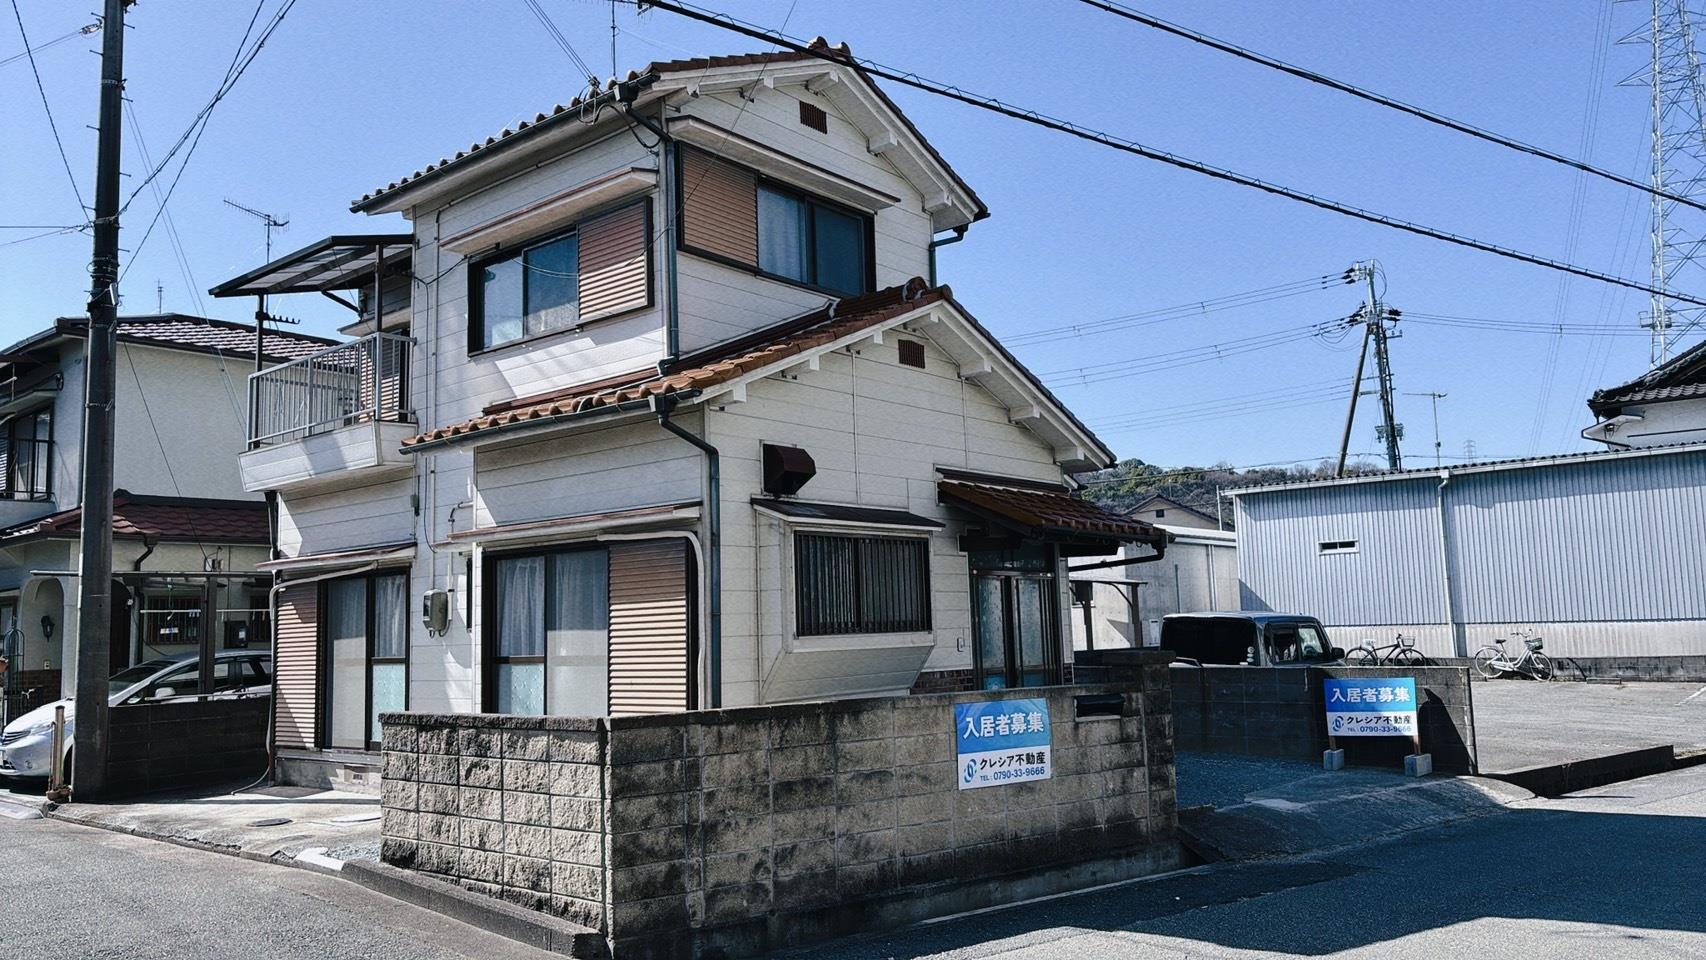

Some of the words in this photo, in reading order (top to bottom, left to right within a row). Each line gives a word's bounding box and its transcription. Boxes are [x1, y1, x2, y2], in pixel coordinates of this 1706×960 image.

[1331, 687, 1410, 702] 入居者募集
[963, 711, 1044, 739] 入居者募集
[1347, 715, 1411, 724] クレシア不動産
[980, 751, 1046, 770] クレシア不動産
[993, 766, 1045, 781] 0790-33-9666
